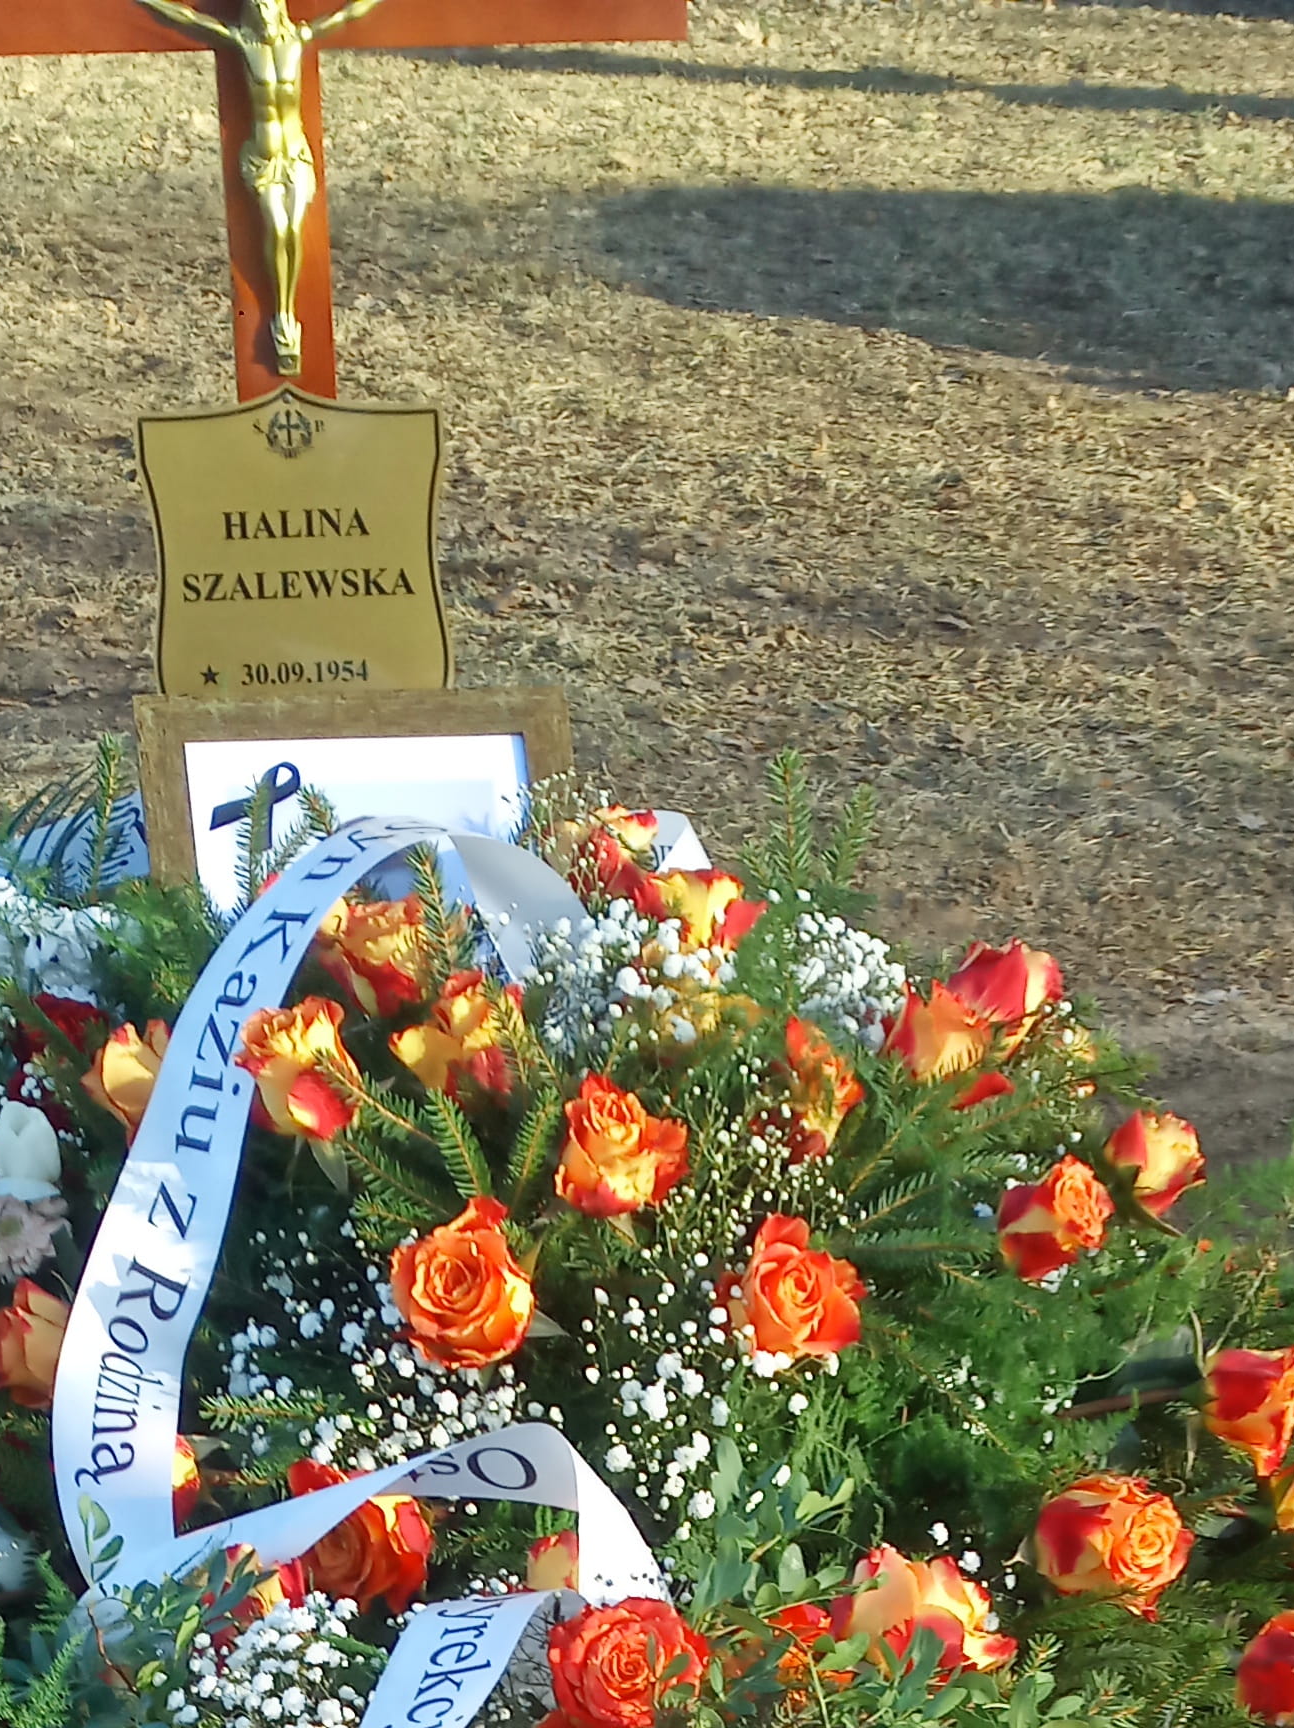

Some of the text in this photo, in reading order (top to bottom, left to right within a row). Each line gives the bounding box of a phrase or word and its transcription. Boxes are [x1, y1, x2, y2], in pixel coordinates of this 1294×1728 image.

[221, 507, 370, 541] HALINA
[182, 567, 416, 603] SZALEWSKA
[240, 659, 369, 686] 30.09.1954
[175, 907, 316, 1159] Kaziu
[148, 1181, 197, 1242] z
[75, 1255, 191, 1488] Rodziną
